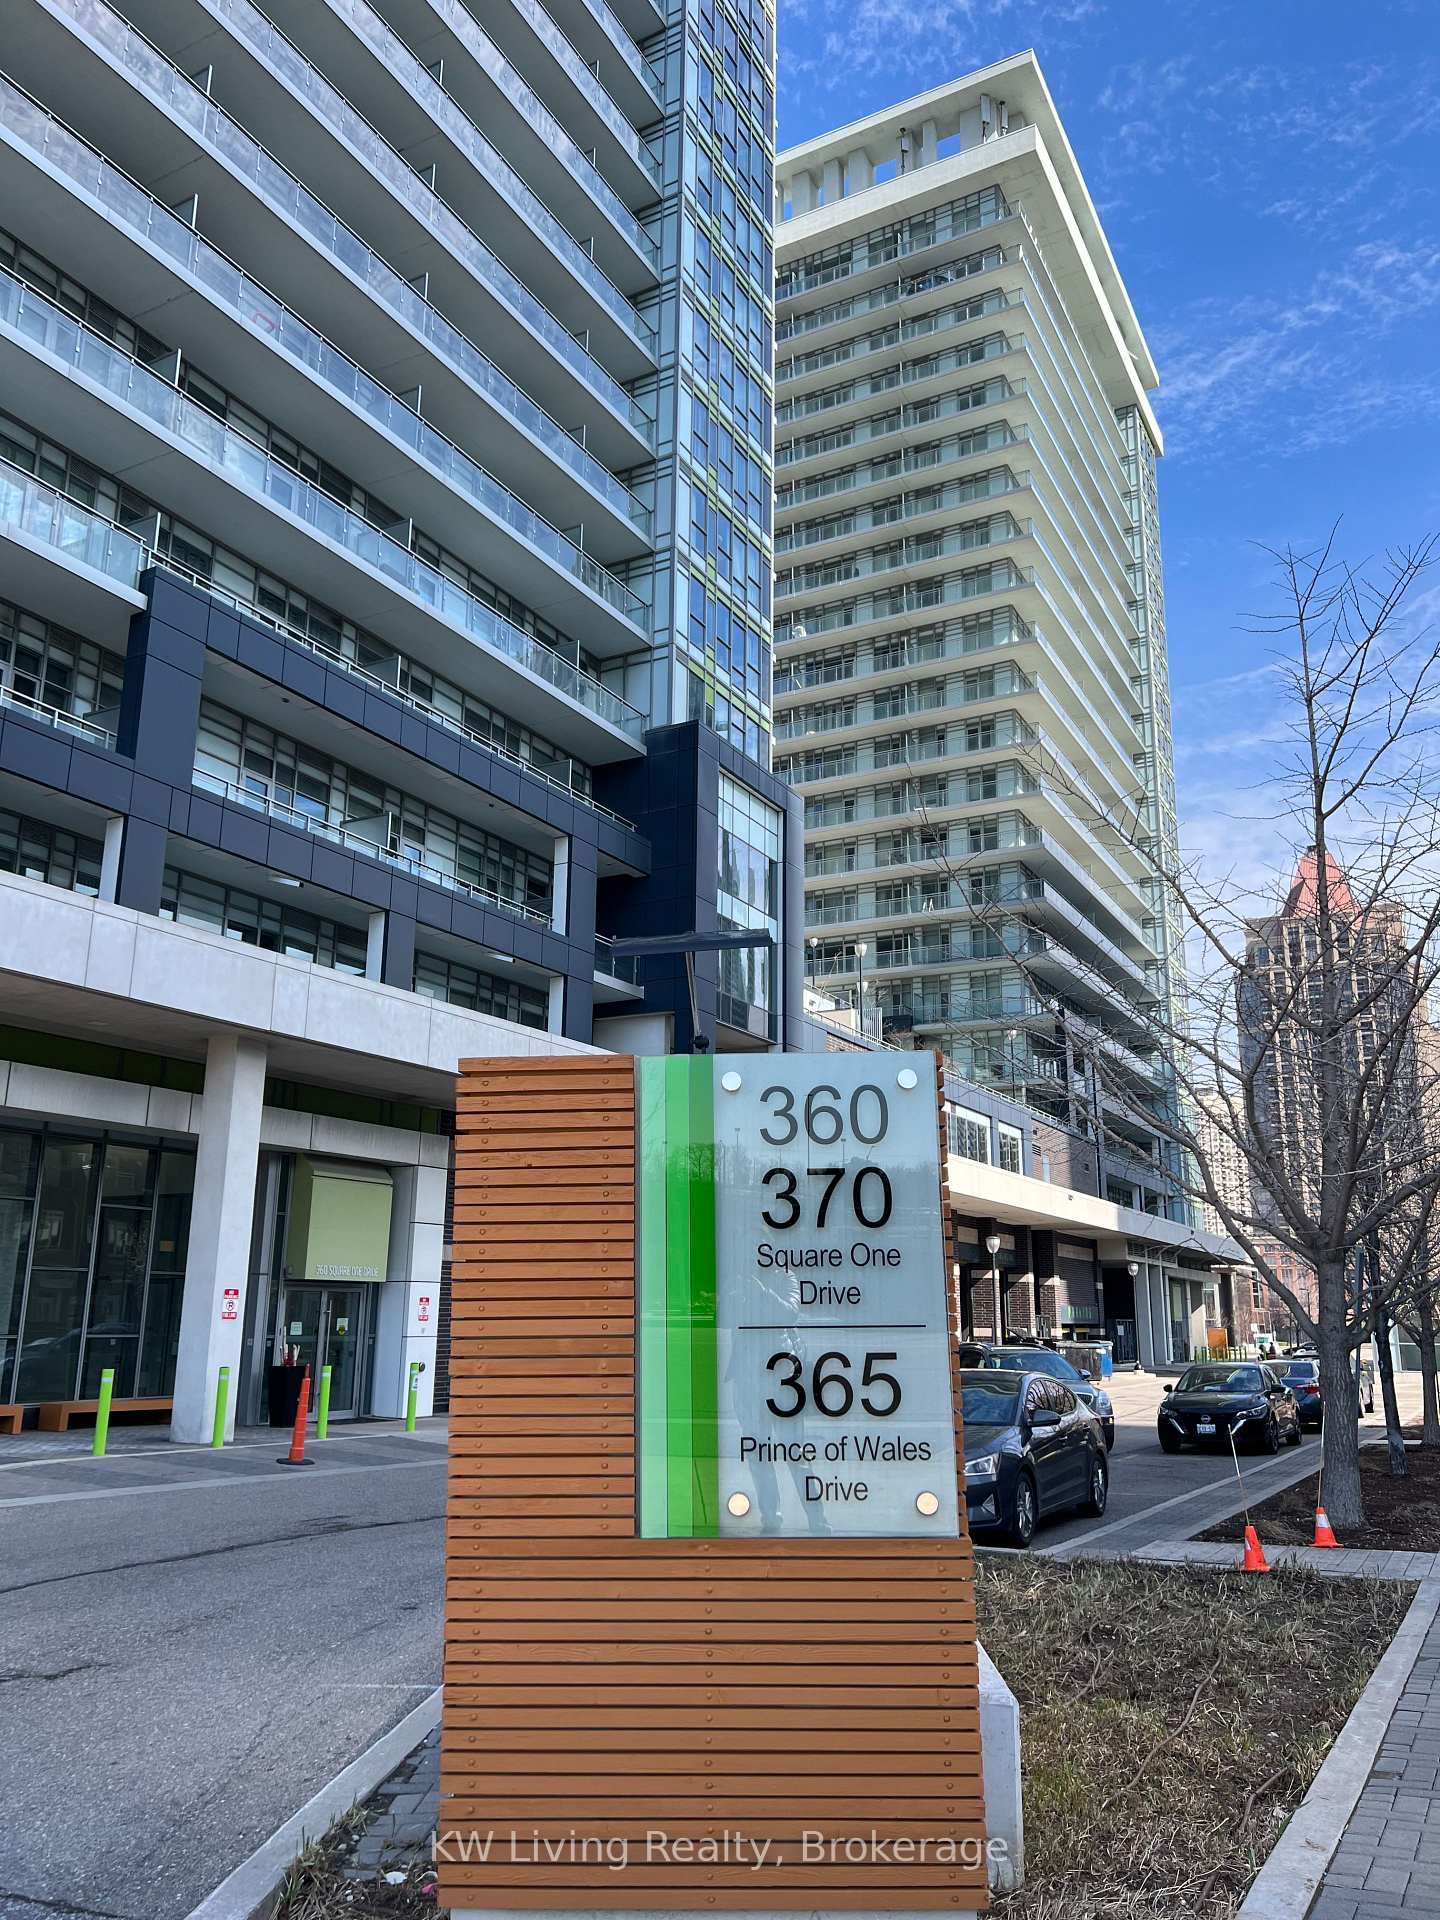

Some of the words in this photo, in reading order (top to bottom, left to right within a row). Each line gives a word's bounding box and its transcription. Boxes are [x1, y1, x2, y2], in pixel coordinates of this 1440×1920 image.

[759, 1084, 889, 1146] 360
[761, 1166, 893, 1230] 370
[757, 1243, 843, 1273] Square
[850, 1242, 901, 1267] One
[799, 1280, 861, 1305] Drive
[765, 1351, 902, 1418] 365
[740, 1436, 816, 1462] Prince
[824, 1436, 848, 1461] of
[854, 1435, 932, 1461] Wales
[805, 1476, 868, 1501] Drive
